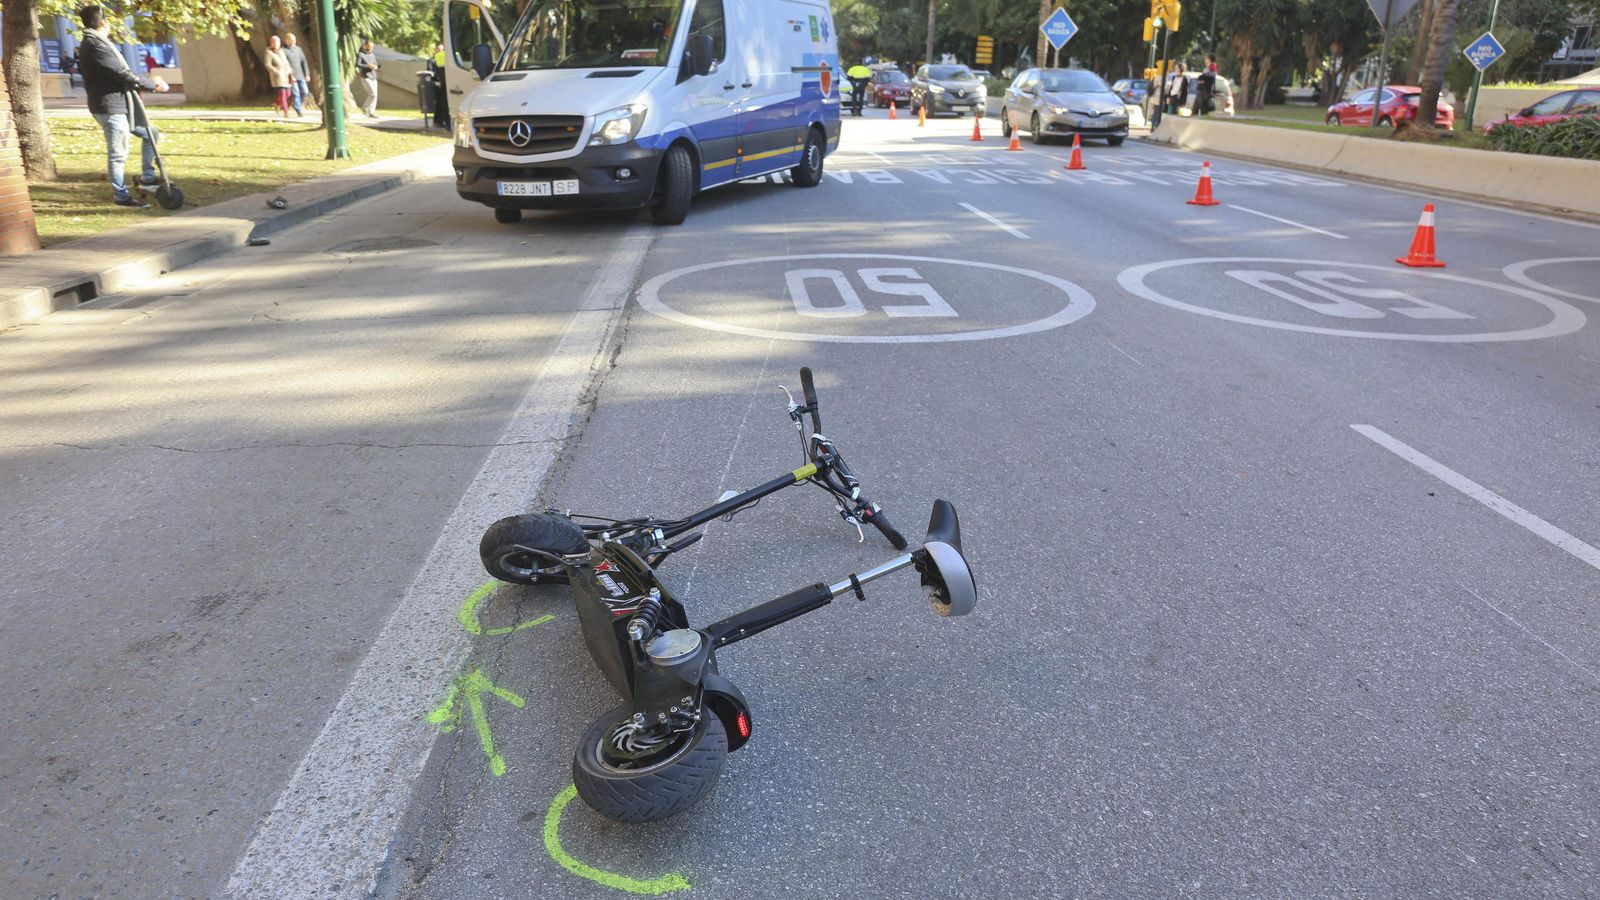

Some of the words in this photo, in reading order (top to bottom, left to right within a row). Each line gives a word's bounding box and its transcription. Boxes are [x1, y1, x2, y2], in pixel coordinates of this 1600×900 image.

[503, 183, 527, 194] 8228
[530, 183, 548, 194] JNT
[556, 181, 576, 193] SP
[784, 267, 959, 318] 50
[1225, 269, 1477, 319] 50
